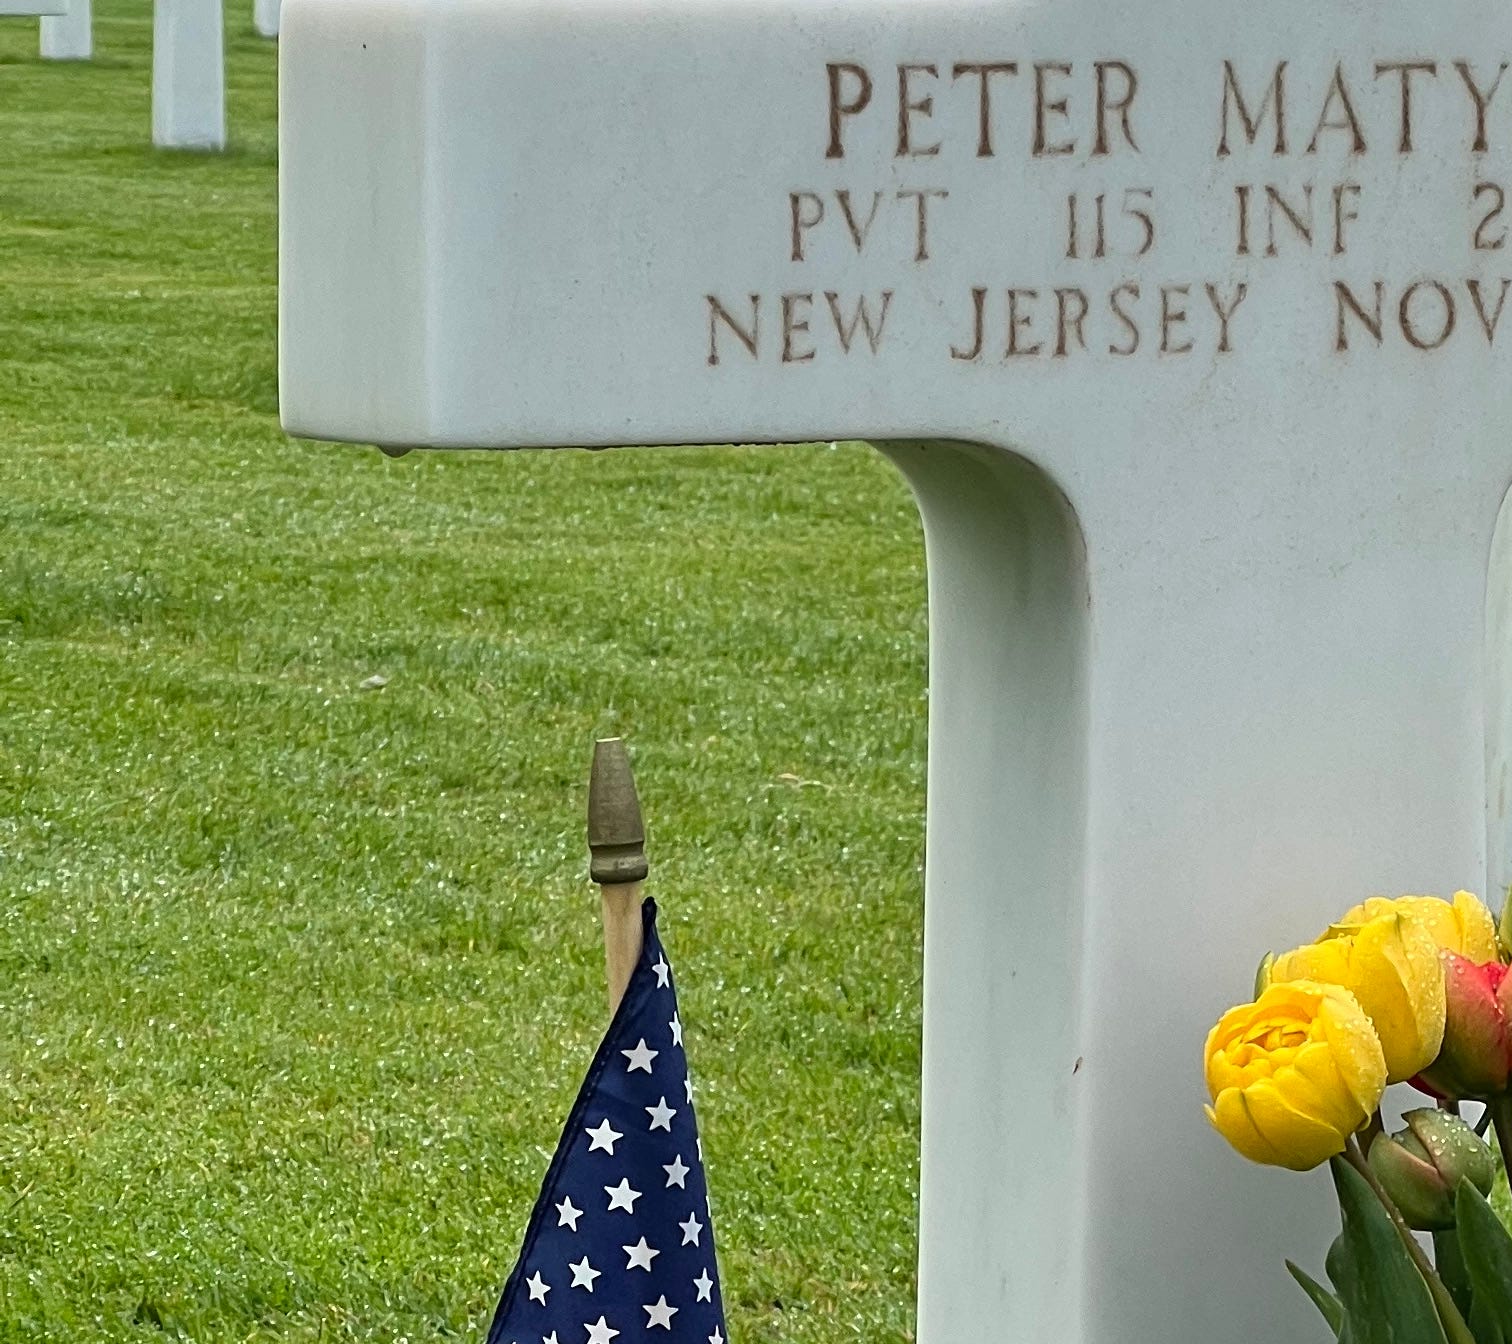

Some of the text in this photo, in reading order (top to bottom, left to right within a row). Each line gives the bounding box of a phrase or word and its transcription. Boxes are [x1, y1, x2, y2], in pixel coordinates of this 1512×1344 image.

[824, 59, 1140, 160] PETER
[788, 189, 949, 266] PVT
[1065, 187, 1155, 259] 115
[1234, 179, 1362, 258] INF
[1252, 192, 1320, 271] 21
[703, 290, 894, 367] NEW
[949, 280, 1248, 364] JERSEY
[1332, 278, 1512, 355] NOV
